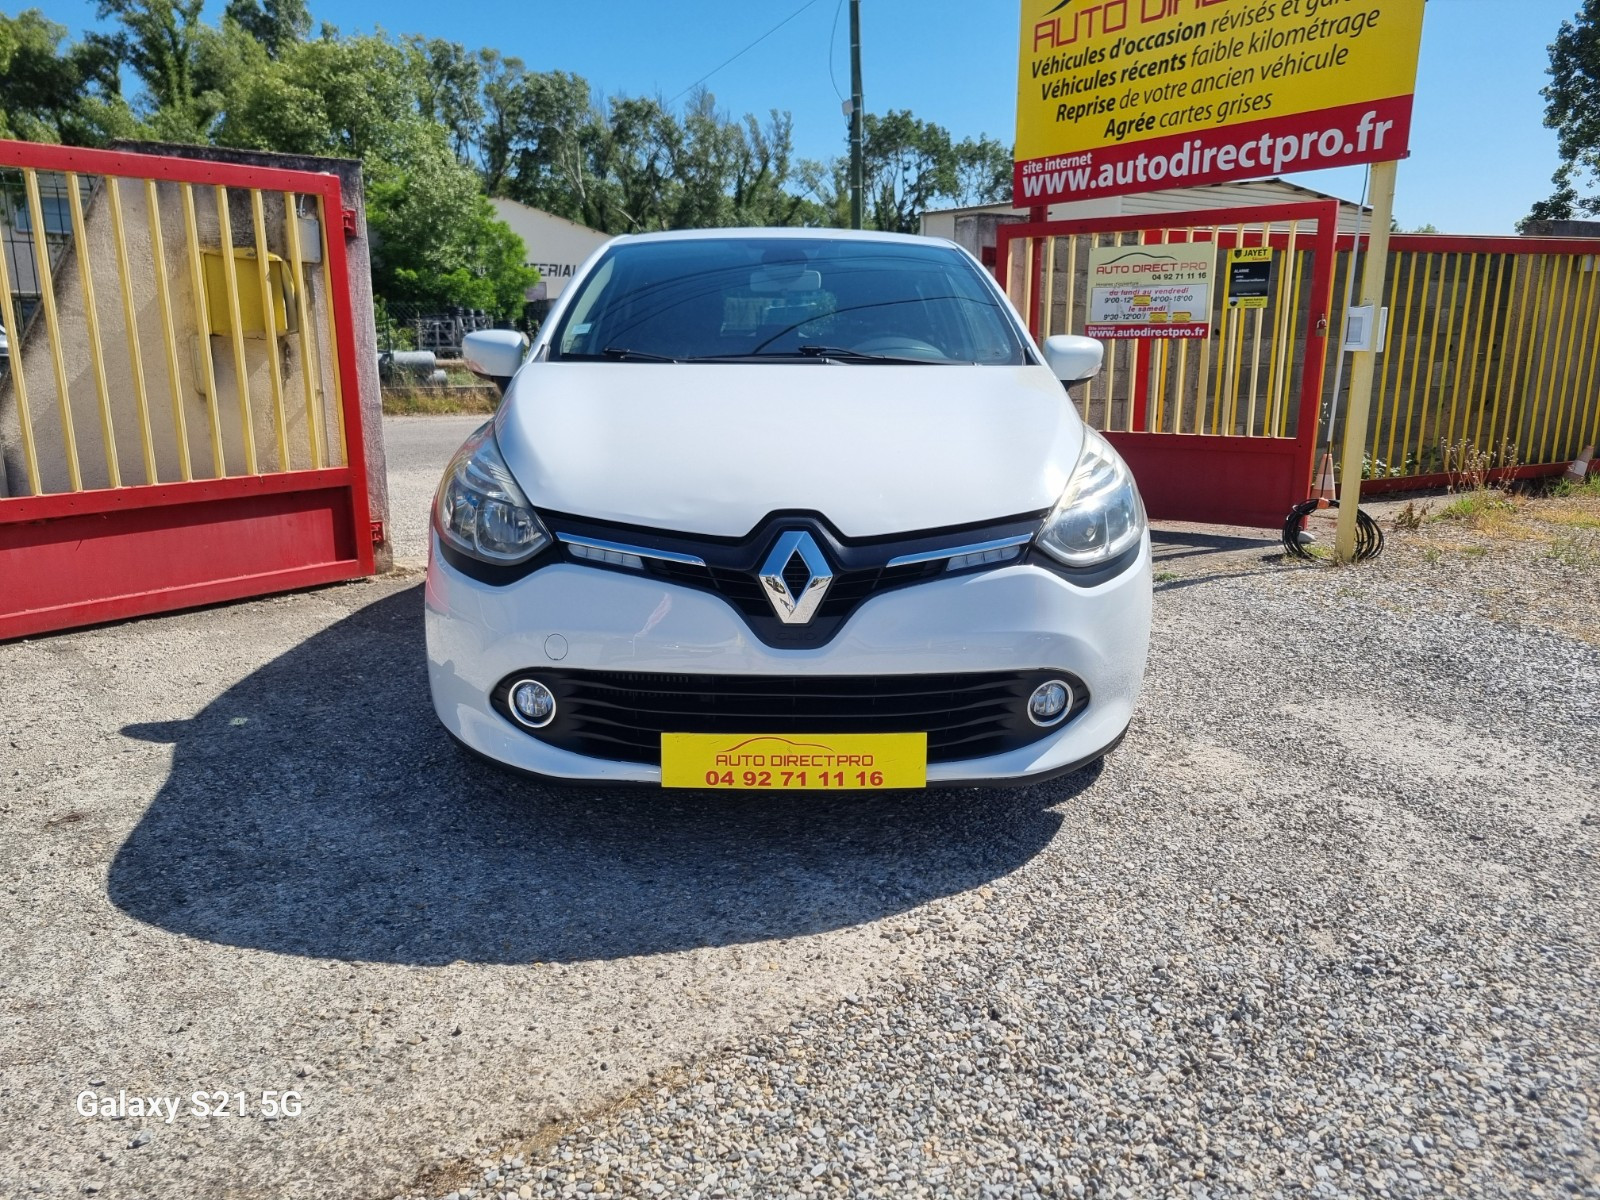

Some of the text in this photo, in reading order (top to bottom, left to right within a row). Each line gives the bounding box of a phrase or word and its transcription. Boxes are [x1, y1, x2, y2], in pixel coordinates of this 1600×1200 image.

[1033, 0, 1128, 52] AUTO
[1032, 46, 1106, 79] Véhicules
[1109, 21, 1207, 60] d'occasion
[1210, 0, 1276, 35] révisés
[1281, 0, 1301, 18] et
[1042, 9, 1381, 101] Véhicules récents faible kilométrage
[1056, 43, 1350, 123] Reprise de votre ancien véhicule
[1103, 93, 1273, 141] Agrée cartes grises
[1022, 110, 1394, 198] www.autodirectpro.fr
[1023, 152, 1093, 176] site internet
[1244, 249, 1268, 257] JAYET
[1096, 261, 1207, 275] AUTO DIRECT PRO
[1154, 287, 1190, 295] vendredi
[1088, 326, 1205, 338] www.autodirectpro.fr
[716, 755, 765, 766] AUTO
[705, 770, 883, 786] 04 92 71 11 16
